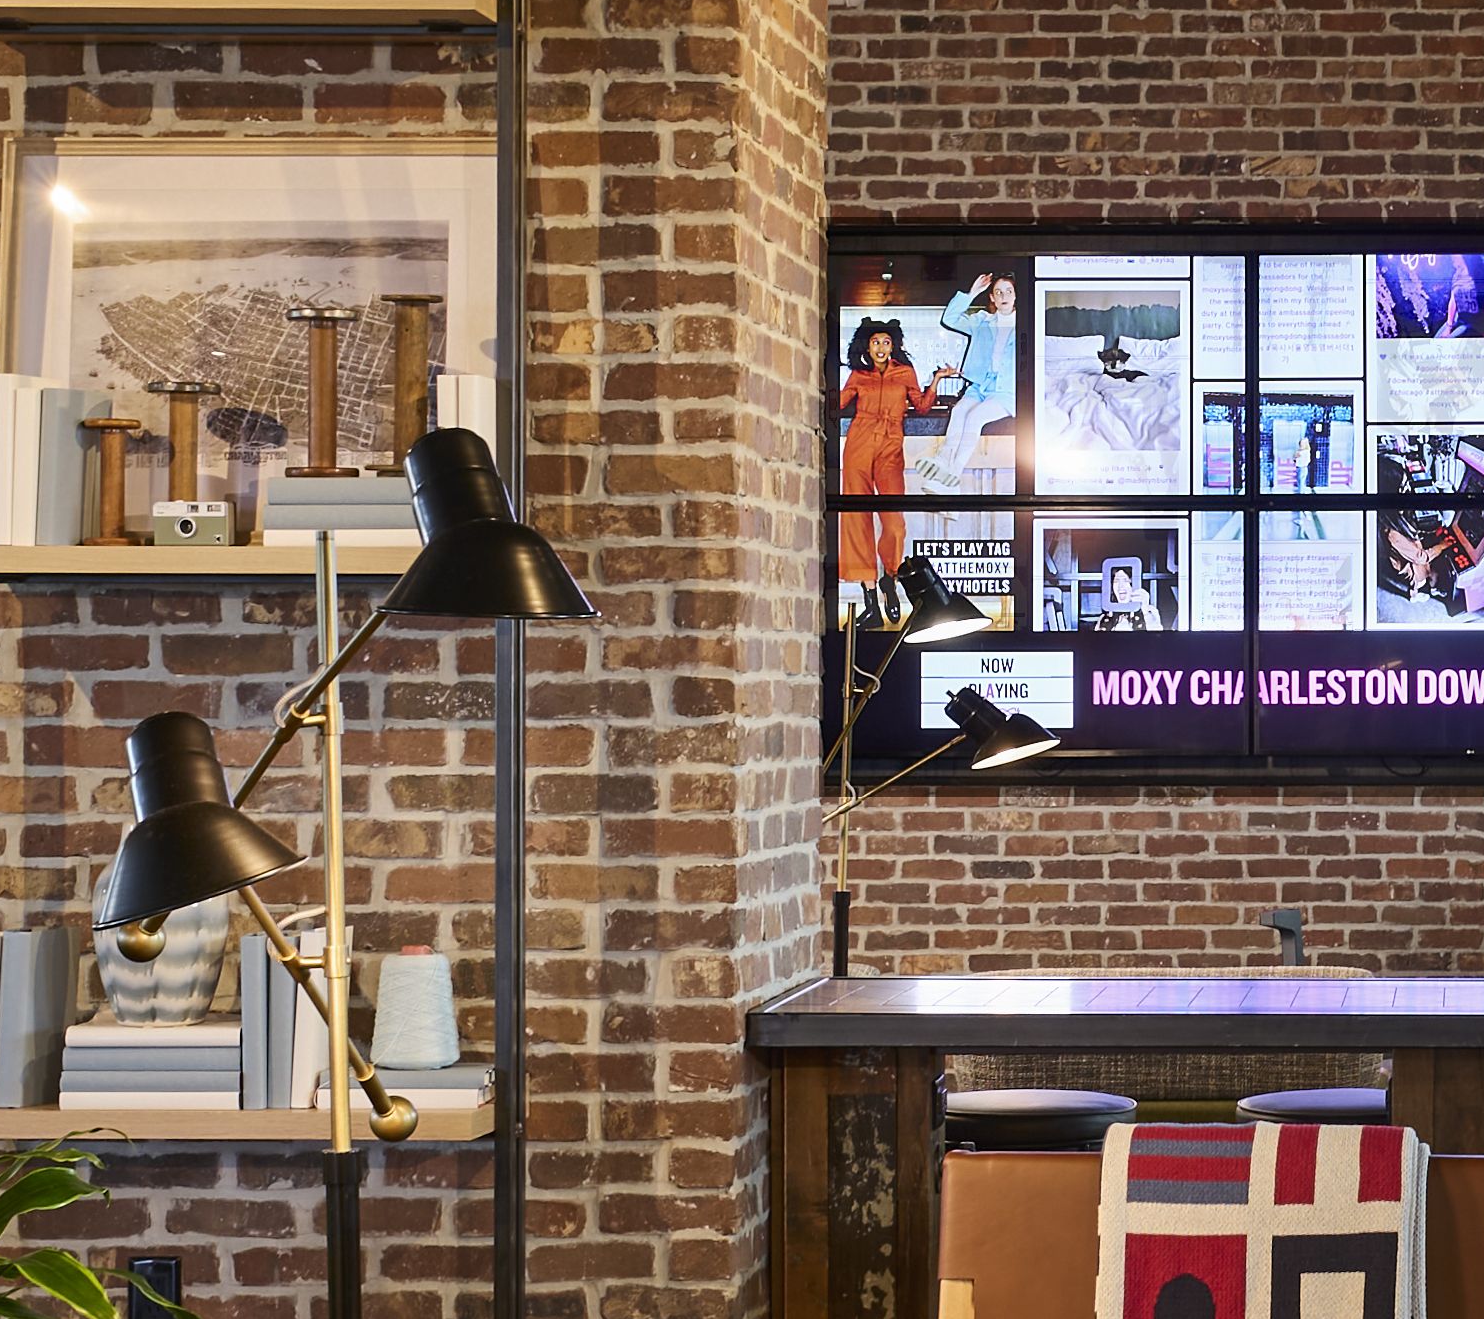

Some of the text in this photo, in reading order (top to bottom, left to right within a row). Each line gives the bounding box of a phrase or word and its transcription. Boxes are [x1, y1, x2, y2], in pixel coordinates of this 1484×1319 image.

[916, 542, 1011, 556] LET'S PLAY TAG
[933, 562, 1009, 574] ATTHEMOXY
[943, 579, 1011, 593] XYHOTELS
[981, 658, 1014, 673] NOW
[1092, 670, 1183, 705] MOXY
[1190, 668, 1408, 705] CHARLESTON
